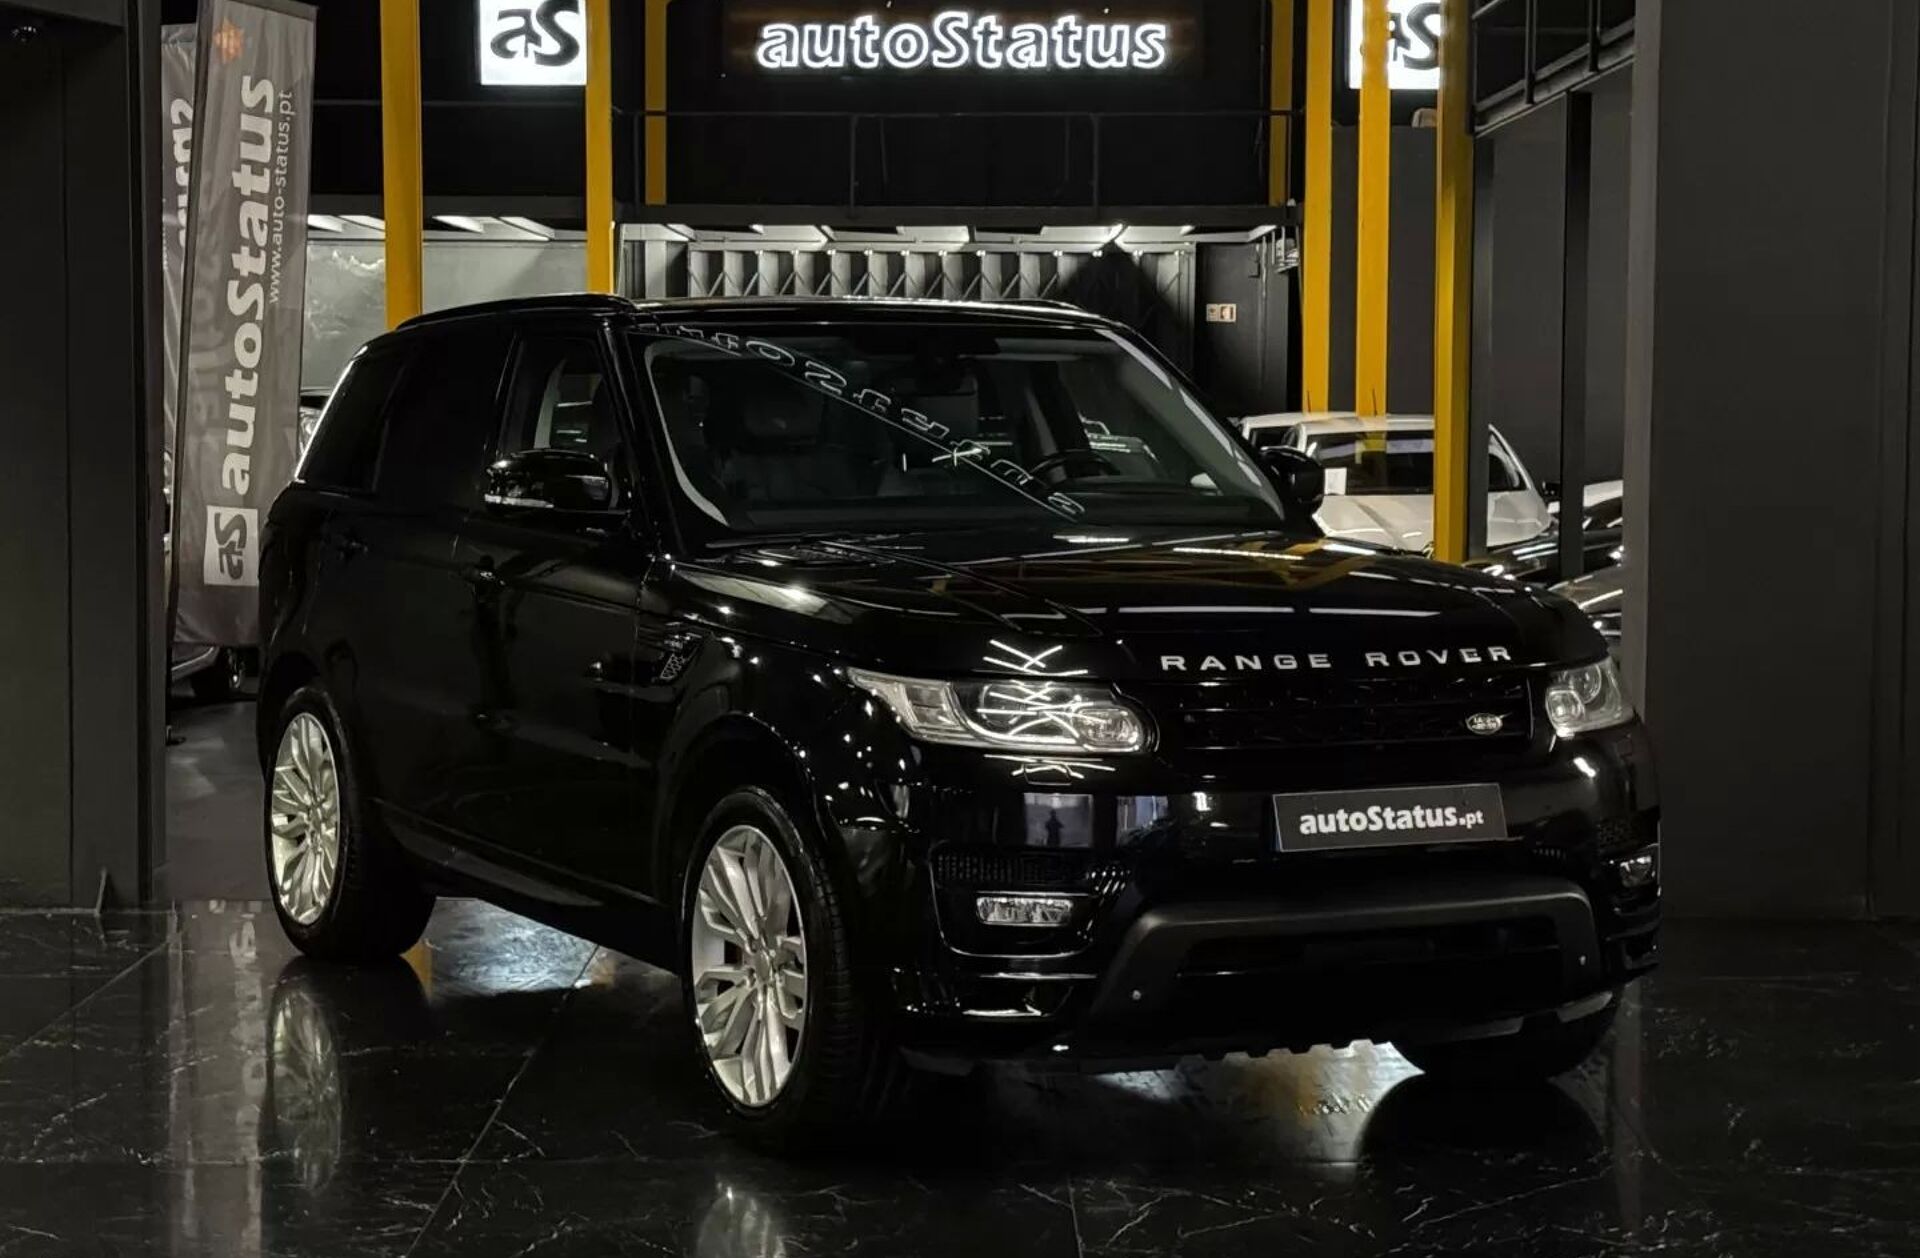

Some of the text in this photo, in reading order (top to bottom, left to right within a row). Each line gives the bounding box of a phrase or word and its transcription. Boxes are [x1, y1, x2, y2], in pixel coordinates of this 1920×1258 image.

[755, 12, 1168, 70] autoStatus
[269, 89, 295, 304] www.auto-status.pt
[221, 75, 275, 496] autoStatus
[1161, 646, 1512, 672] RANGE ROVER
[1299, 804, 1485, 835] autoStatus.pt
